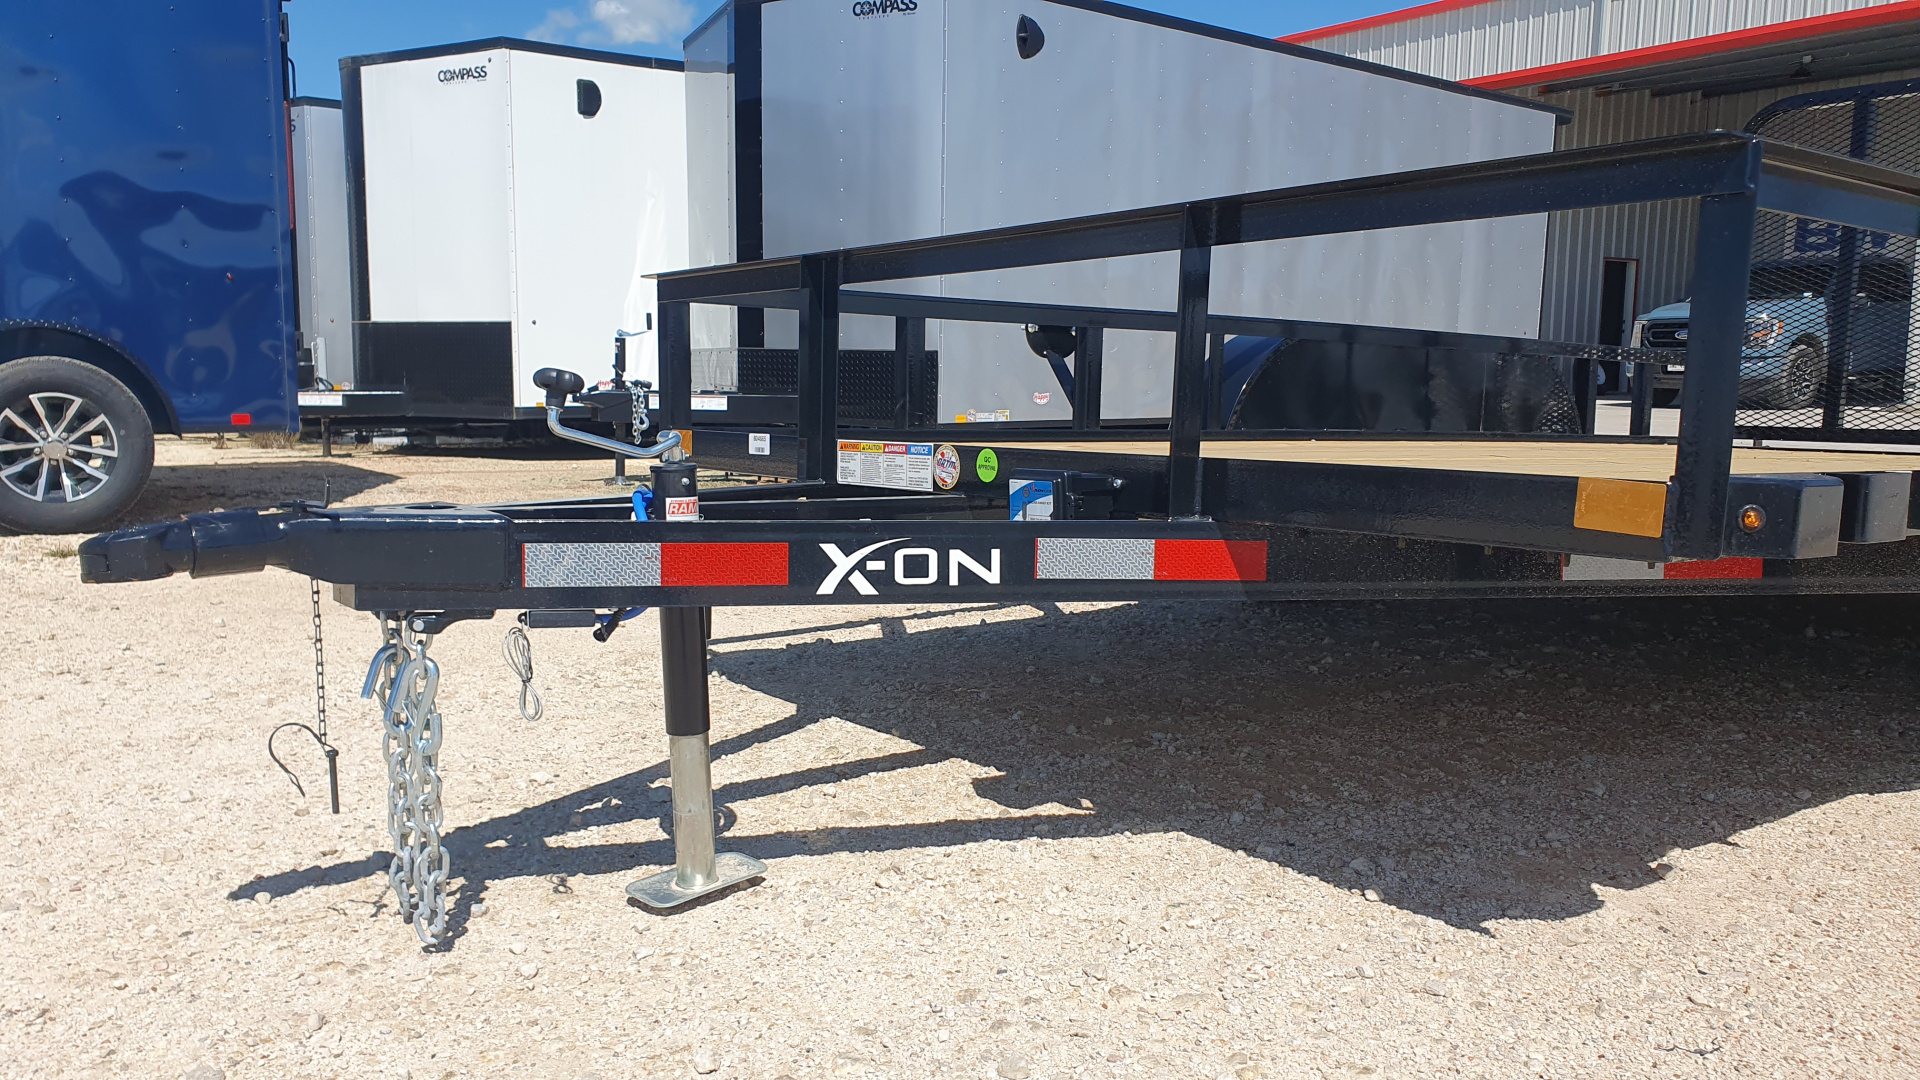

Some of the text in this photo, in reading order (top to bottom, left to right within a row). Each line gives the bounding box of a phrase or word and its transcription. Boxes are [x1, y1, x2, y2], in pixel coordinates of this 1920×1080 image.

[852, 0, 918, 16] COMPASS
[438, 65, 487, 82] COMPASS
[842, 442, 860, 450] WARNING
[865, 443, 883, 452] CAUTION
[888, 444, 906, 453] DANGER
[911, 445, 929, 454] NOTICE
[668, 502, 697, 514] RAM
[815, 537, 1001, 596] X-ON
